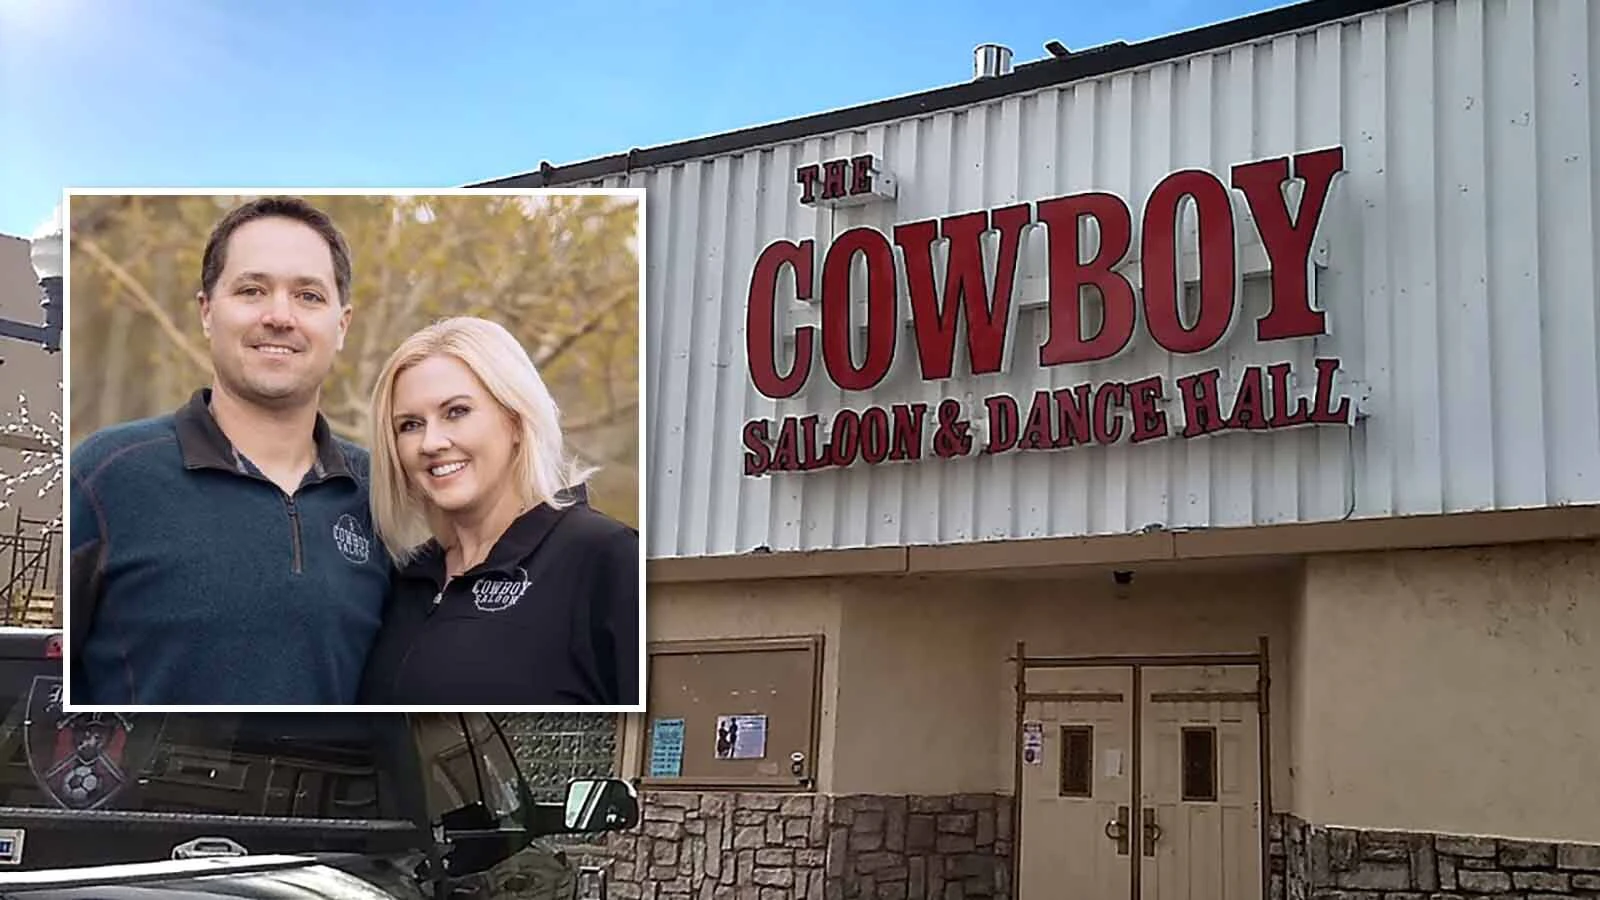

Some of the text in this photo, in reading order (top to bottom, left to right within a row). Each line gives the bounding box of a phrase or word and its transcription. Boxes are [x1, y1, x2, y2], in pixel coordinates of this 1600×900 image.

[796, 154, 874, 204] THE
[745, 146, 1345, 400] COWBOY
[743, 358, 1351, 476] SALOON & DANCE HALL
[333, 525, 370, 553] COWBOY
[471, 579, 533, 596] COWBOY
[475, 594, 520, 605] SALOON
